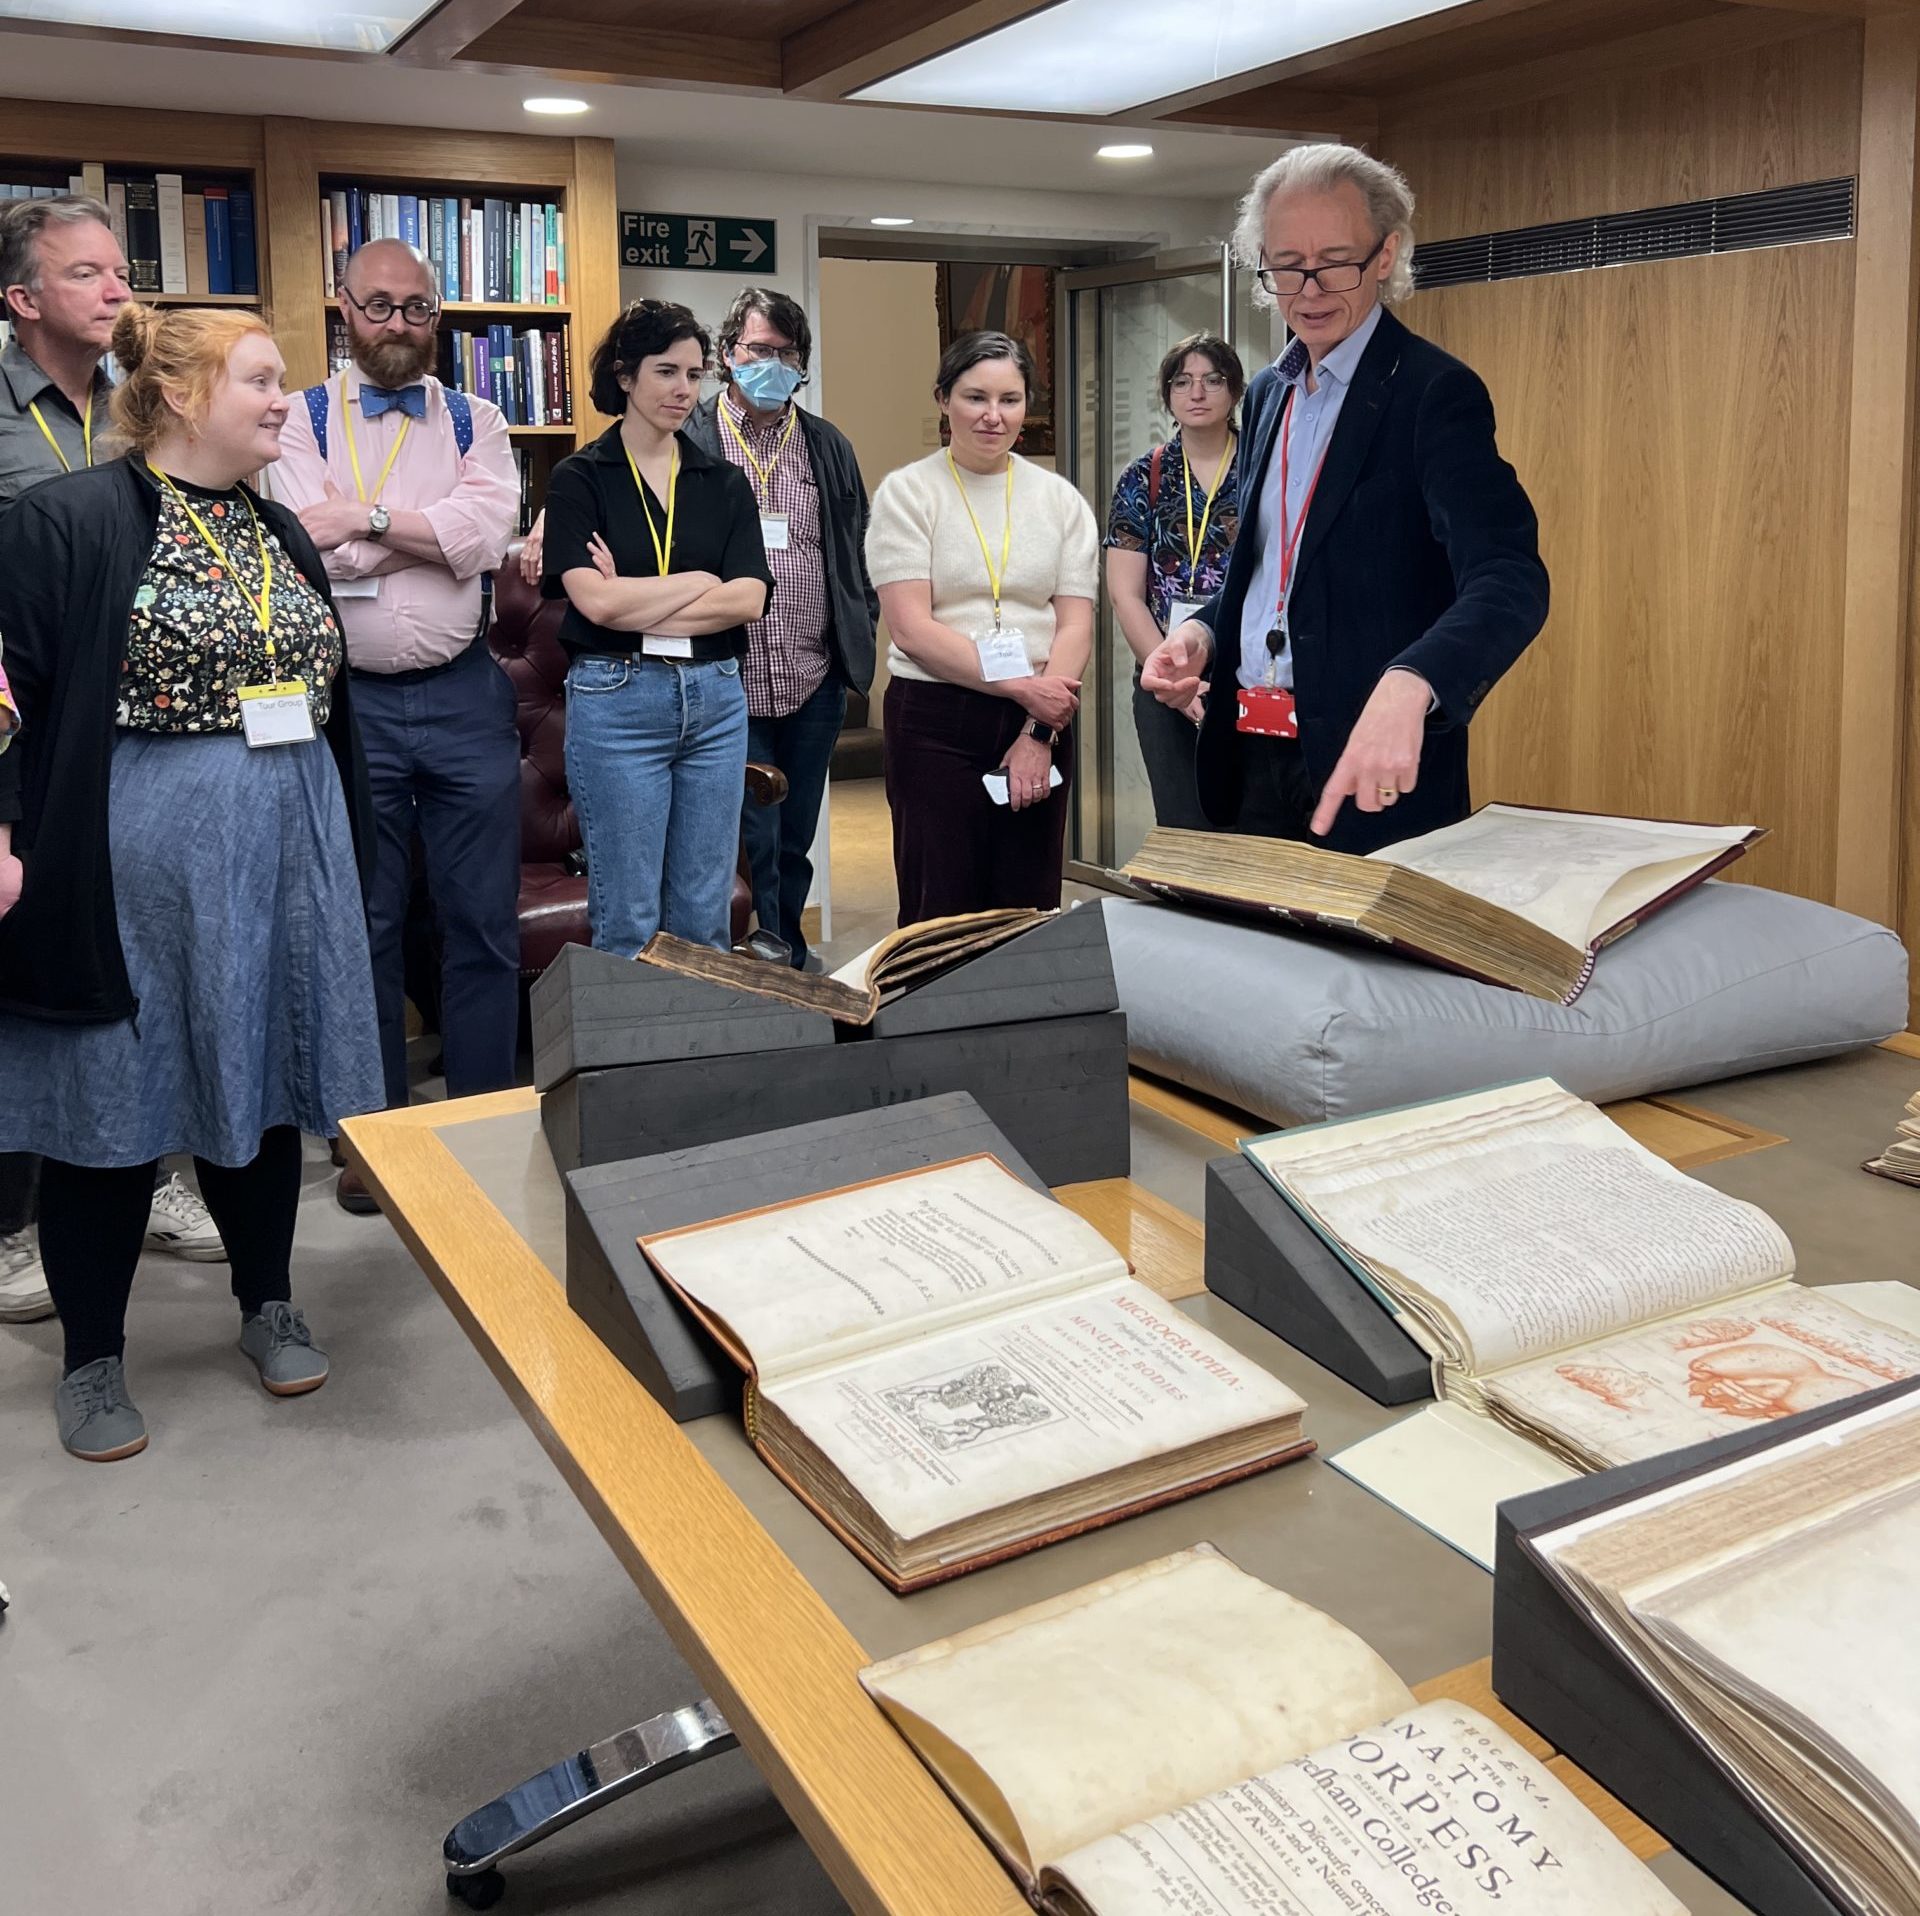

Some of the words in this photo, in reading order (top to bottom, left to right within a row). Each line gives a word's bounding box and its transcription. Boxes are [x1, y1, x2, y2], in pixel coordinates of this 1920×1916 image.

[624, 215, 670, 238] Fire
[625, 244, 670, 265] exit
[1070, 1315, 1131, 1358] MINUTE
[1132, 1360, 1188, 1400] BODIES
[1111, 1296, 1244, 1391] MICROGRAPHIA:
[1426, 1773, 1444, 1790] OF
[1441, 1790, 1452, 1799] A
[1462, 1747, 1479, 1762] OR
[1481, 1763, 1506, 1788] THE
[1231, 1800, 1252, 1814] of
[1245, 1815, 1302, 1877] ANIMALS.
[1322, 1815, 1350, 1846] WITH
[1350, 1848, 1360, 1857] A
[1341, 1734, 1513, 1899] ORPESS,
[1353, 1773, 1411, 1831] DISSECTED
[1413, 1836, 1431, 1850] AT
[1176, 1875, 1214, 1916] LONDO
[1286, 1831, 1312, 1855] and
[1307, 1856, 1317, 1865] a
[1316, 1864, 1361, 1911] Natural
